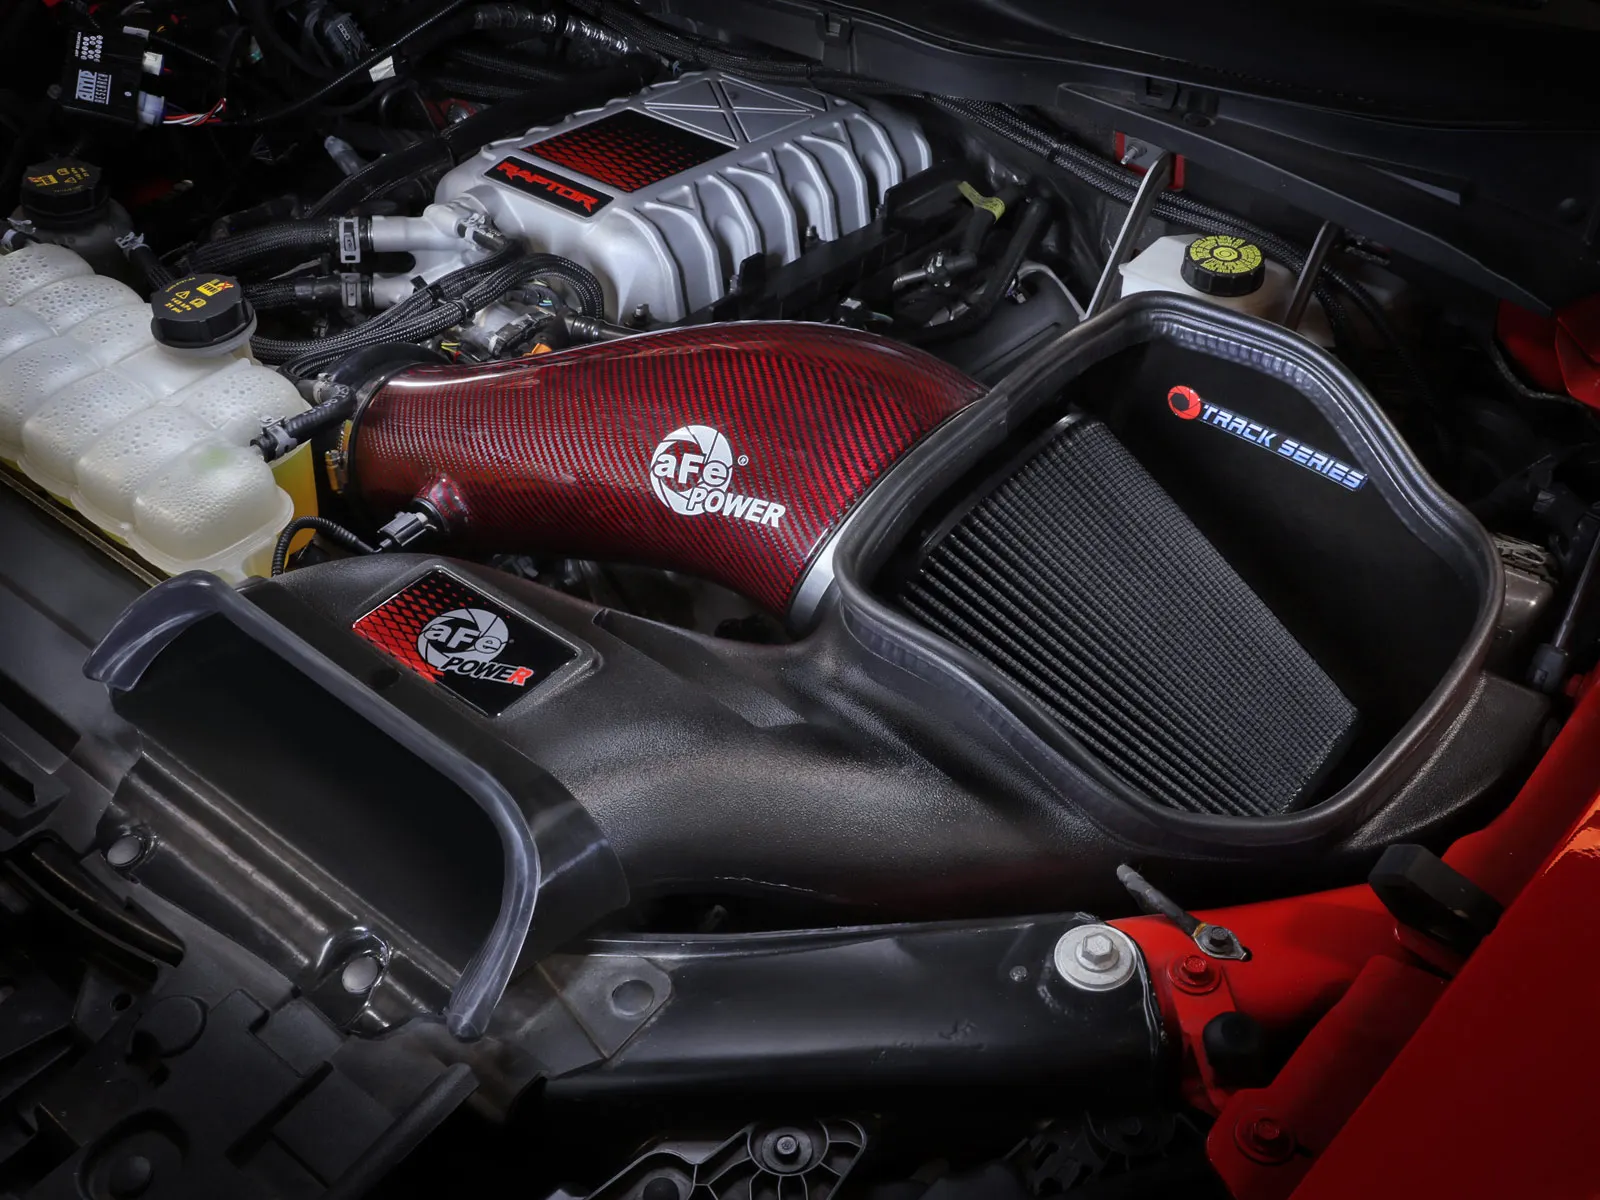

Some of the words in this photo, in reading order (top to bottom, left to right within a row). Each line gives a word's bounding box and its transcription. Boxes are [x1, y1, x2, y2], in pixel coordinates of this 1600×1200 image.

[77, 69, 96, 102] AMP
[94, 73, 108, 104] RESEARCH
[496, 161, 599, 213] RAPTOR
[1202, 403, 1279, 448] TRACK
[1277, 439, 1367, 489] SERIES
[653, 452, 729, 487] aFe
[687, 487, 787, 528] POWER
[423, 623, 503, 655] aFe
[438, 656, 535, 687] POWER
